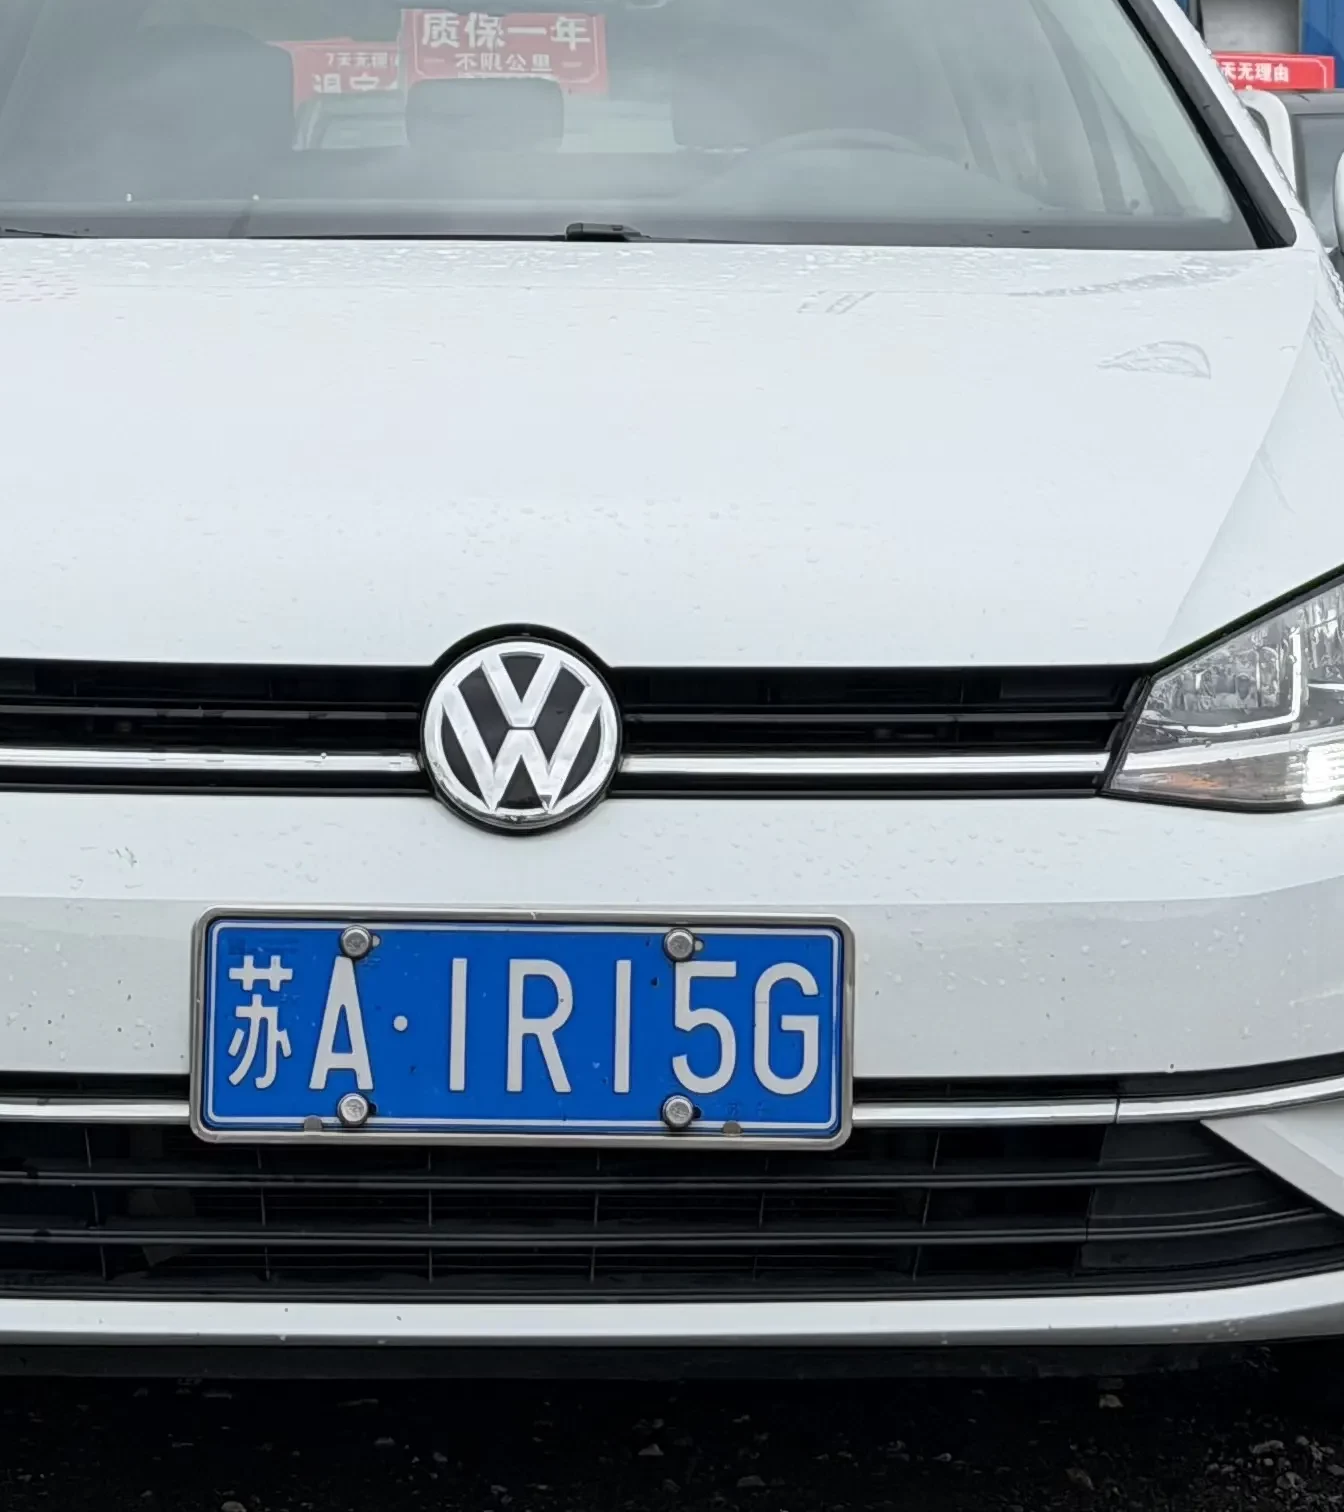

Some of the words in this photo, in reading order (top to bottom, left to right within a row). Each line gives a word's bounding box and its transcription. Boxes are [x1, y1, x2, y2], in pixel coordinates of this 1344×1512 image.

[421, 12, 592, 51] 质保一年
[455, 52, 553, 73] 不限公里
[431, 644, 611, 820] VW
[228, 955, 821, 1094] 苏A·1R15G
